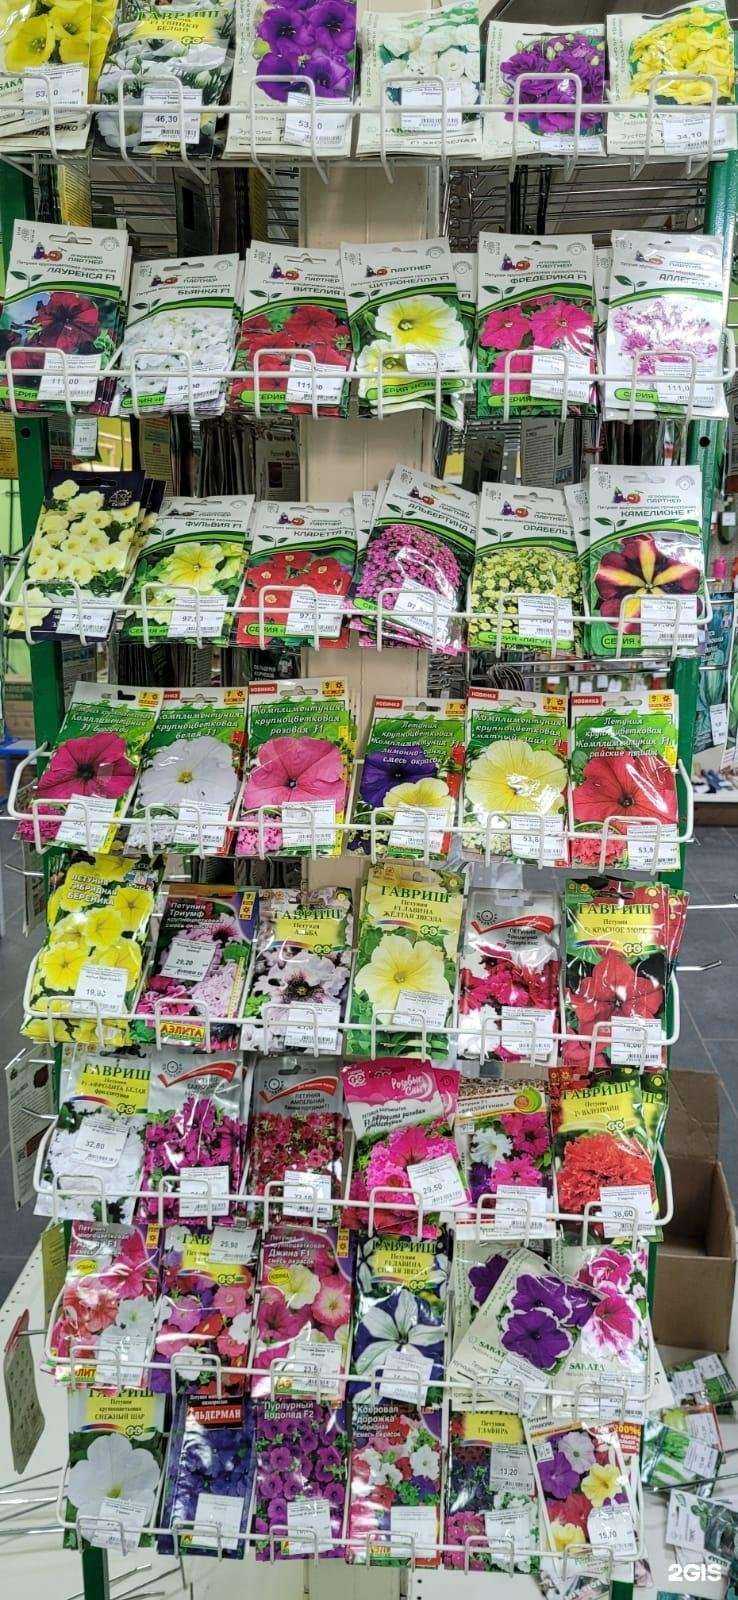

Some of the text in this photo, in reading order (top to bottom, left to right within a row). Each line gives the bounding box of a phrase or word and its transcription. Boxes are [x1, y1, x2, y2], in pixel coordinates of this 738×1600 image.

[35, 89, 59, 97] 53,0
[154, 115, 178, 123] 46,30
[298, 121, 323, 130] 53,0
[47, 267, 103, 280] ЛАУРЕНСА
[510, 274, 575, 284] ФРЕДЕРИКА
[620, 509, 682, 517] КАМЕЛИОНЕ
[185, 520, 229, 528] ФУЛЬВИЯ
[523, 525, 568, 535] ОРАБЕЛЬ
[249, 625, 278, 633] СЕИЯ
[604, 637, 635, 645] СЕИЯ
[255, 715, 341, 725] крупноцветковая
[381, 886, 452, 903] ГАВРИШ
[169, 909, 204, 918] Триумф
[578, 904, 651, 915] ГАВРИШ
[160, 1025, 203, 1036] АЭЛИТА
[83, 1063, 151, 1080] ГАВРИШ
[563, 1084, 630, 1100] ГАВРИШ
[268, 1249, 299, 1258] Джина
[479, 1341, 506, 1357] SAKAT
[303, 1410, 314, 1418] F2
